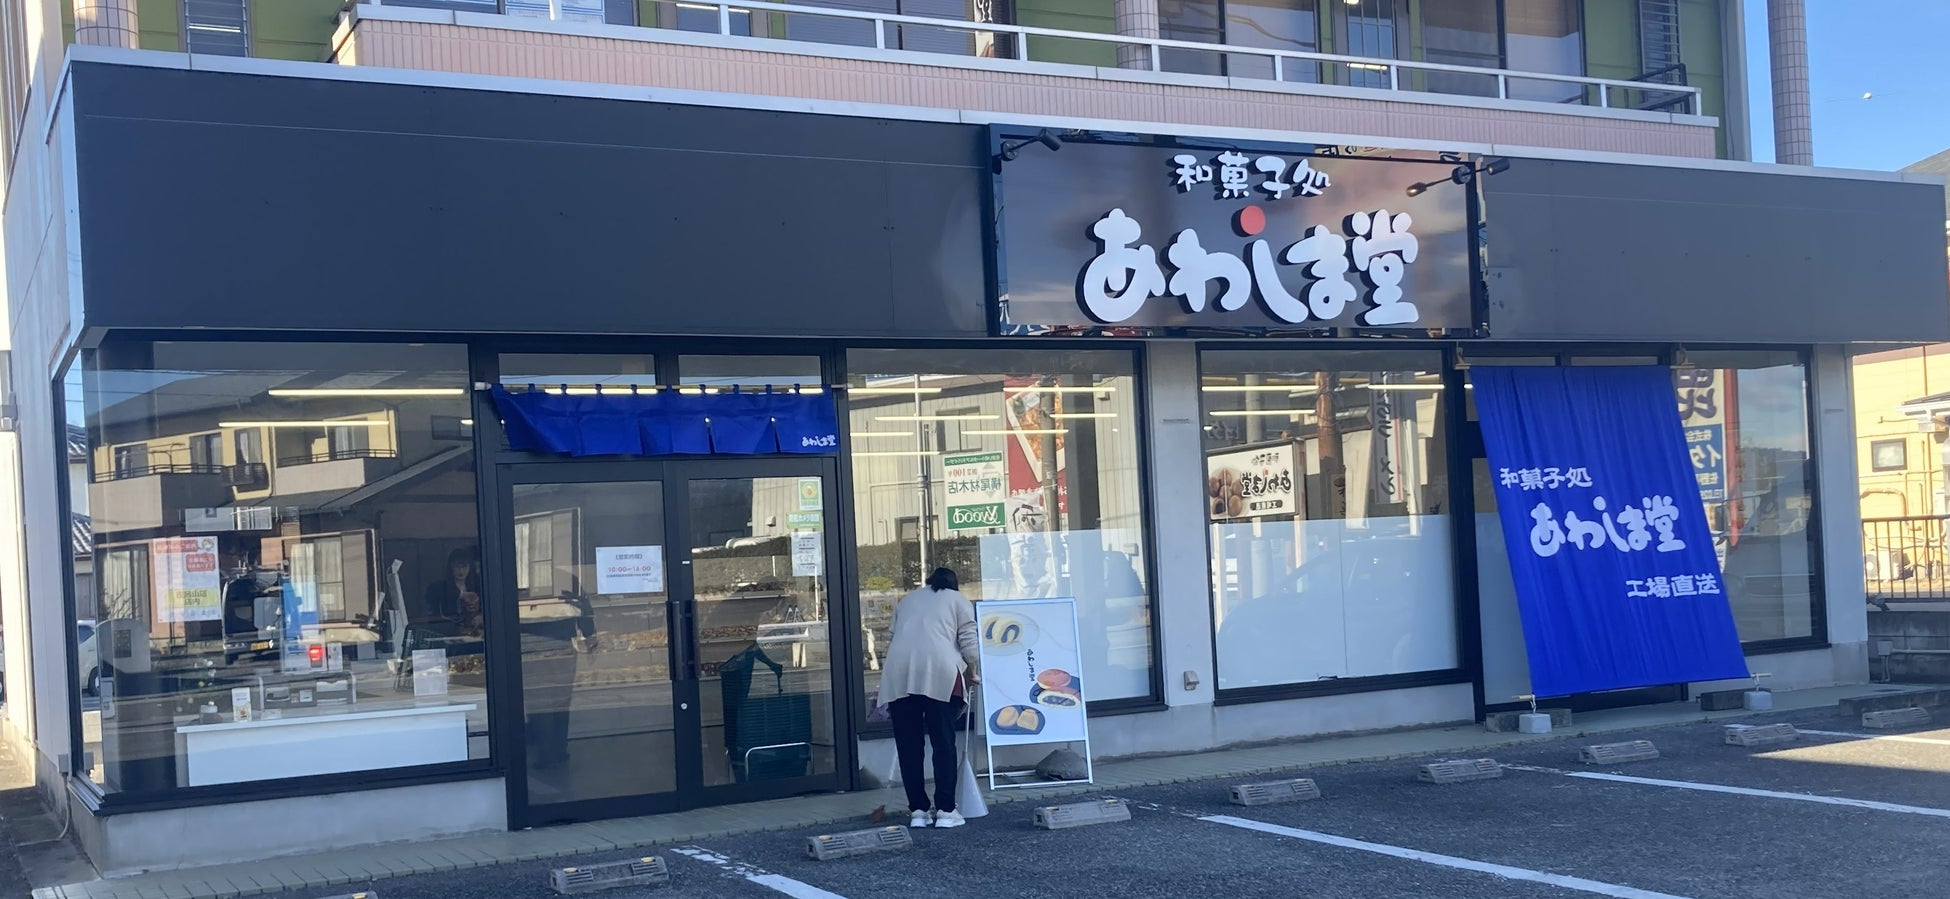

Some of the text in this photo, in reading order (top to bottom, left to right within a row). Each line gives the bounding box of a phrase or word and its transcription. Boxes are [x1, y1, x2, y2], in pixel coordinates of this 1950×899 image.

[1174, 151, 1331, 199] 和菓子処
[1084, 207, 1419, 326] あわしま堂
[802, 434, 837, 447] あわしま堂
[1500, 467, 1593, 491] 和菓子処
[1529, 495, 1686, 557] あわしま堂
[1626, 573, 1720, 598] 工場直送
[1026, 648, 1036, 682] あわしま堂
